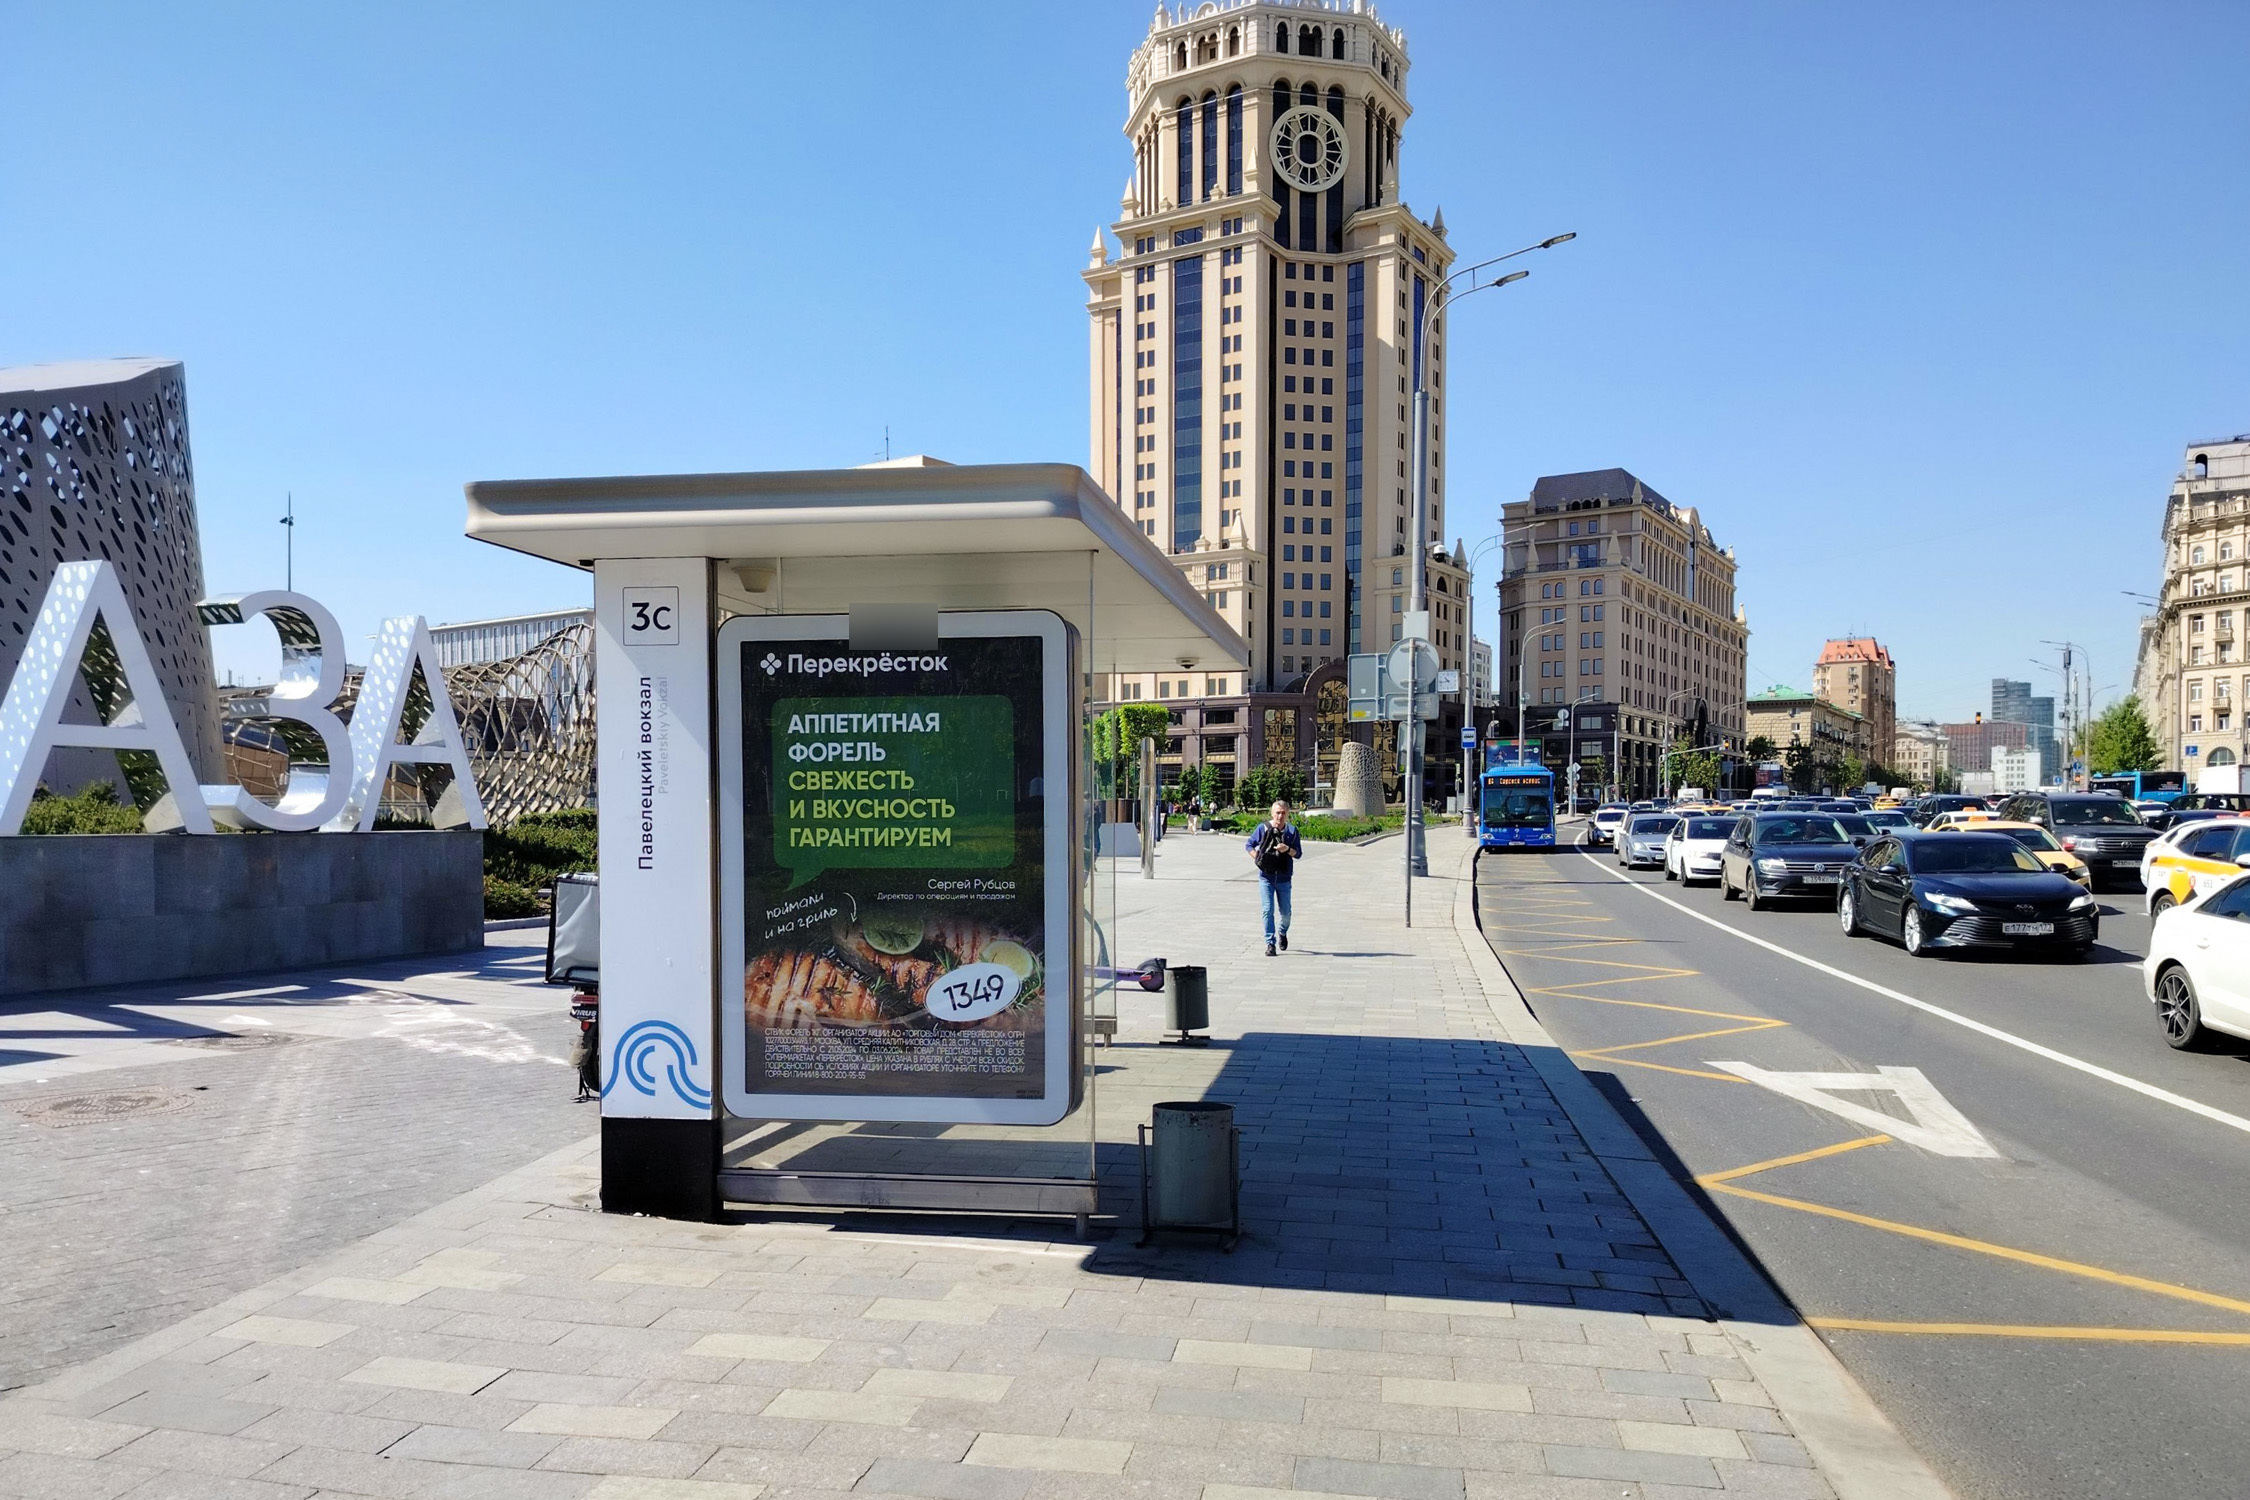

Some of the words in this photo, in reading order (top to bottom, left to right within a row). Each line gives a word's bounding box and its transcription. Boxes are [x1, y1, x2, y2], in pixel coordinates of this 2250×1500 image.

[788, 652, 949, 678] Перекрёсток
[657, 676, 669, 720] Vokzal
[639, 676, 652, 744] вокзал
[787, 712, 940, 734] АППЕТИТНАЯ
[658, 721, 670, 794] Paveletskiy
[788, 742, 886, 762] ФОРЕЛЬ
[788, 770, 915, 791] СВЕЖЕСТЬ
[637, 750, 654, 870] Павелецкий
[789, 800, 805, 819] И
[813, 798, 956, 818] ВКУСНОСТЬ
[790, 827, 951, 847] ГАРАНТИРУЕМ
[927, 878, 971, 891] Сергей
[974, 878, 1016, 891] Рубцов
[766, 893, 824, 920] поймали
[877, 892, 914, 901] Директор
[915, 893, 925, 901] по
[926, 893, 968, 901] операциям
[976, 893, 1016, 901] продажам
[765, 928, 774, 939] и
[777, 922, 794, 935] на
[797, 907, 838, 928] гриль
[942, 974, 1004, 1011] 1349
[785, 1028, 811, 1036] ФОРЕЛЬ
[823, 1028, 867, 1037] ОРГАНИЗАТОР
[940, 1030, 956, 1038] ДОМ
[977, 1039, 1025, 1047] ПРЕДЛОЖЕНИЕ
[765, 1045, 817, 1053] ДЕЙСТВИТЕЛЬНО
[859, 1046, 869, 1054] ПО
[936, 1047, 982, 1055] ПРЕДСТАВЛЕН
[995, 1048, 1006, 1056] ВО
[1008, 1048, 1025, 1056] ВСЕХ
[765, 1053, 815, 1061] СУПЕРМАРКЕТАХ
[884, 1055, 912, 1063] УКАЗАНА
[765, 1062, 813, 1070] ПОДРОБНОСТИ
[814, 1062, 824, 1070] ОБ
[890, 1064, 940, 1072] ОРГАНИЗАТОРЕ
